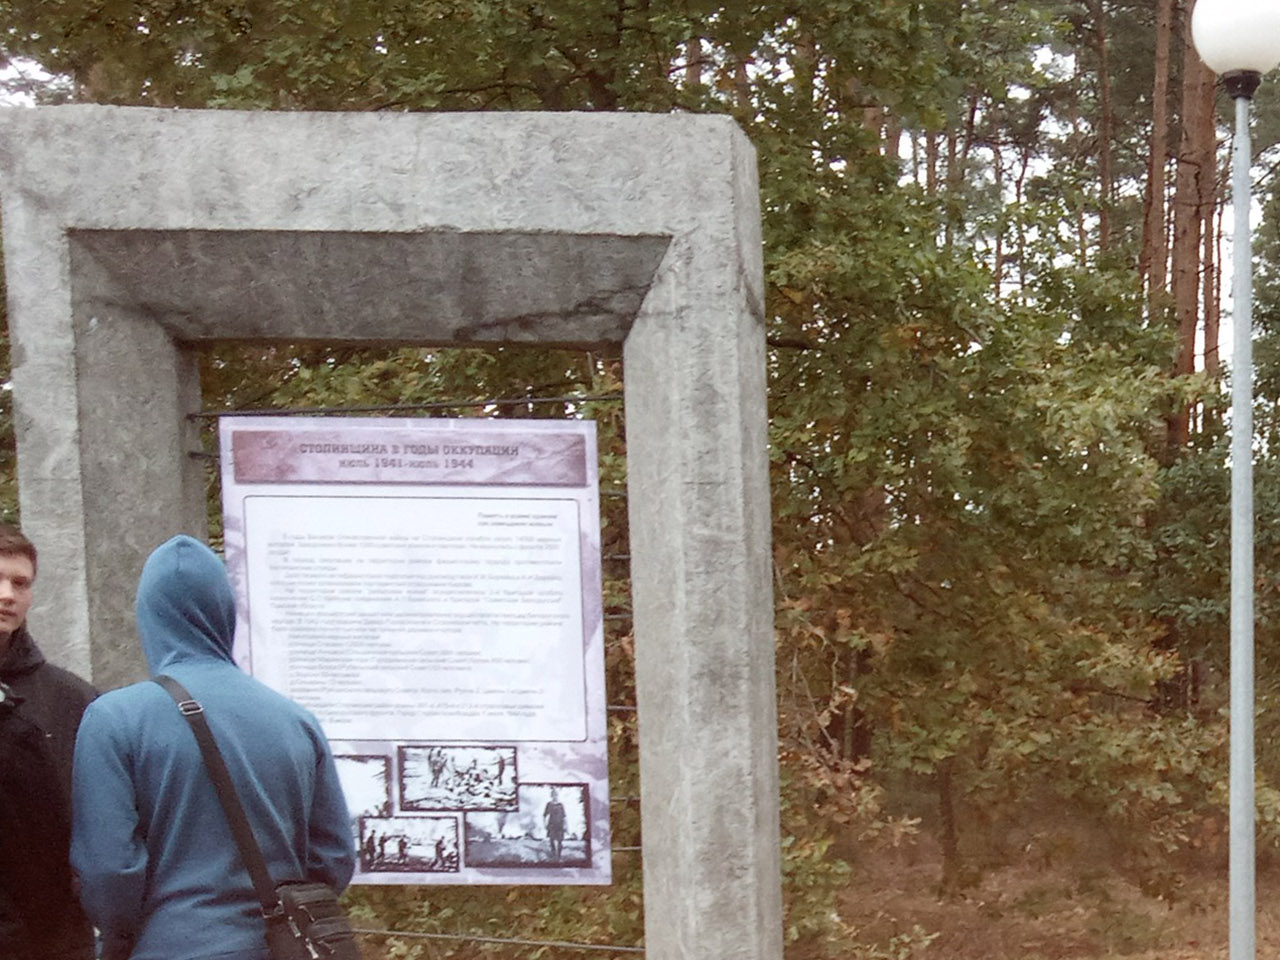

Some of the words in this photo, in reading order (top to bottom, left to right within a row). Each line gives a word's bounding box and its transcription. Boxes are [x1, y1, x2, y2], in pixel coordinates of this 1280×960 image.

[391, 444, 401, 455] В
[403, 444, 439, 456] ГОДЫ
[443, 445, 520, 457] ОККУПАЦИИ
